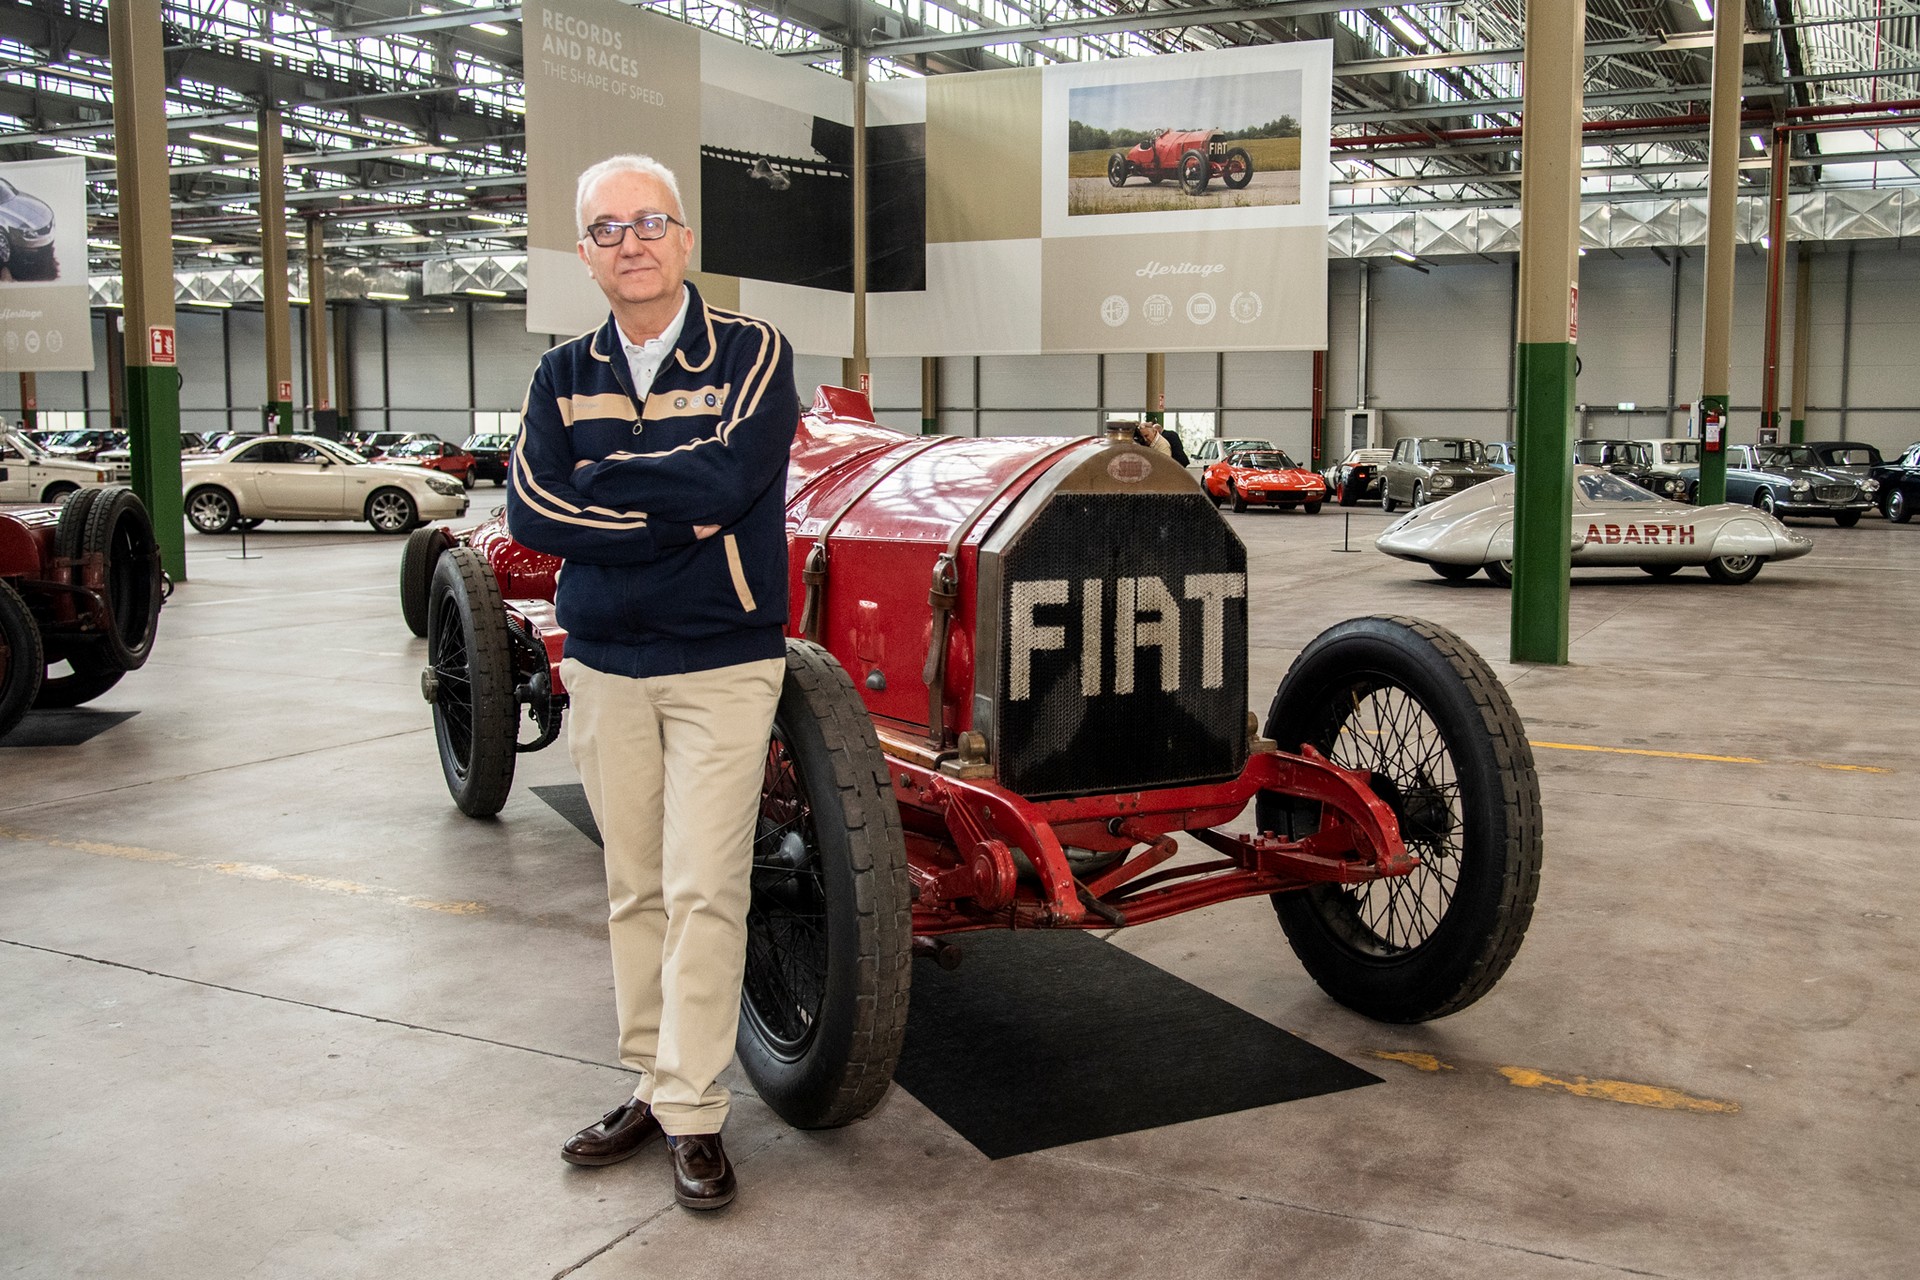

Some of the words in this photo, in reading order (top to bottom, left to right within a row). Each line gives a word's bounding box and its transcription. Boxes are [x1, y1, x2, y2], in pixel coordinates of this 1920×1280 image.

[542, 8, 622, 50] RECORDS
[542, 33, 581, 60] AND
[587, 46, 639, 78] RACES
[542, 59, 567, 81] THE
[570, 67, 609, 92] SHAPE
[611, 80, 627, 96] OF
[629, 85, 666, 107] SPEED.
[1209, 141, 1228, 155] FIAT
[1135, 260, 1225, 278] Heritage
[1149, 303, 1166, 317] FIAT
[1584, 523, 1695, 545] ABARTH
[1009, 572, 1246, 702] FIAT
